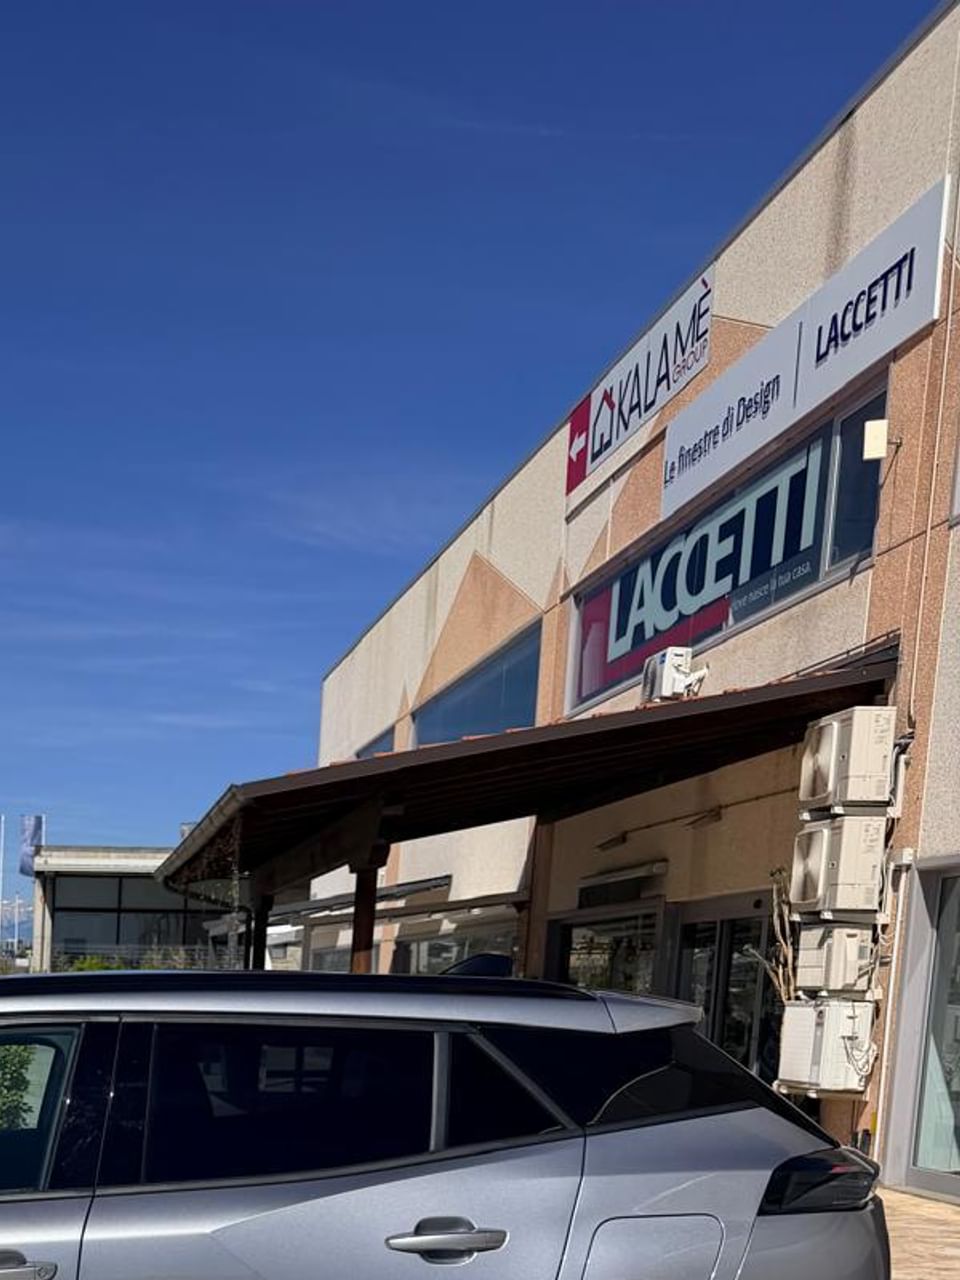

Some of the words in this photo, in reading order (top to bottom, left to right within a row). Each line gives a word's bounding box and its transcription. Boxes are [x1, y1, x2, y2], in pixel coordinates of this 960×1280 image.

[672, 338, 709, 384] GROUP
[816, 247, 916, 366] LACCETTI
[664, 460, 676, 486] Le
[677, 425, 720, 475] finestre
[721, 406, 734, 440] di
[736, 374, 781, 430] Design
[607, 437, 824, 664] LACCETTI
